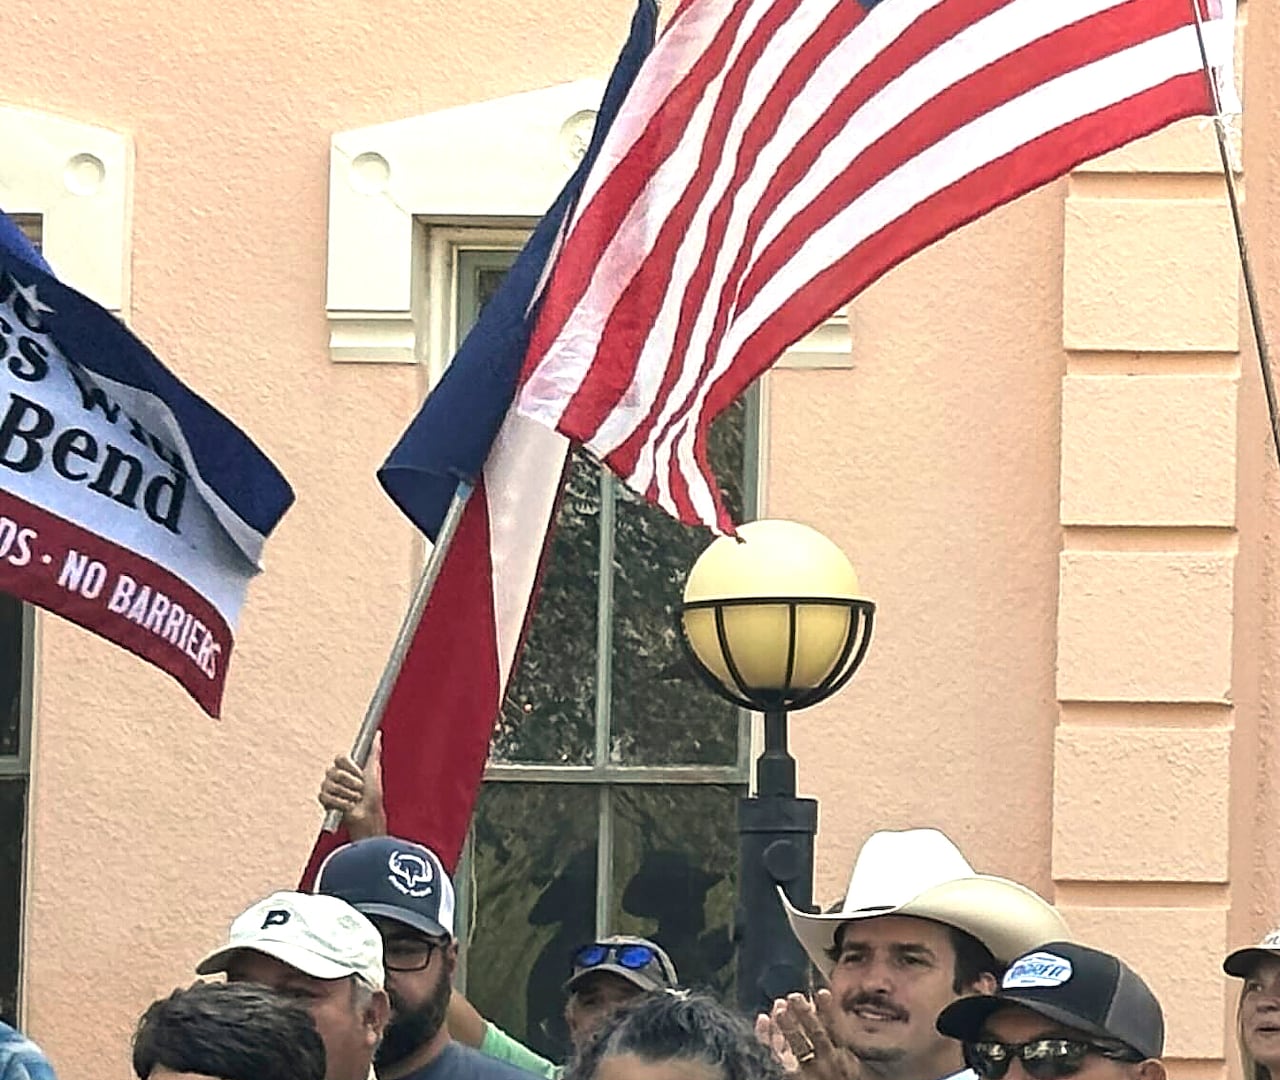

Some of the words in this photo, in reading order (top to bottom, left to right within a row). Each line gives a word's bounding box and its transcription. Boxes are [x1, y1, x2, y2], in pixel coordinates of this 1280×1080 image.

[0, 392, 190, 535] Bend
[57, 550, 107, 599] NO
[107, 575, 221, 679] BARRIERS
[260, 909, 292, 930] P
